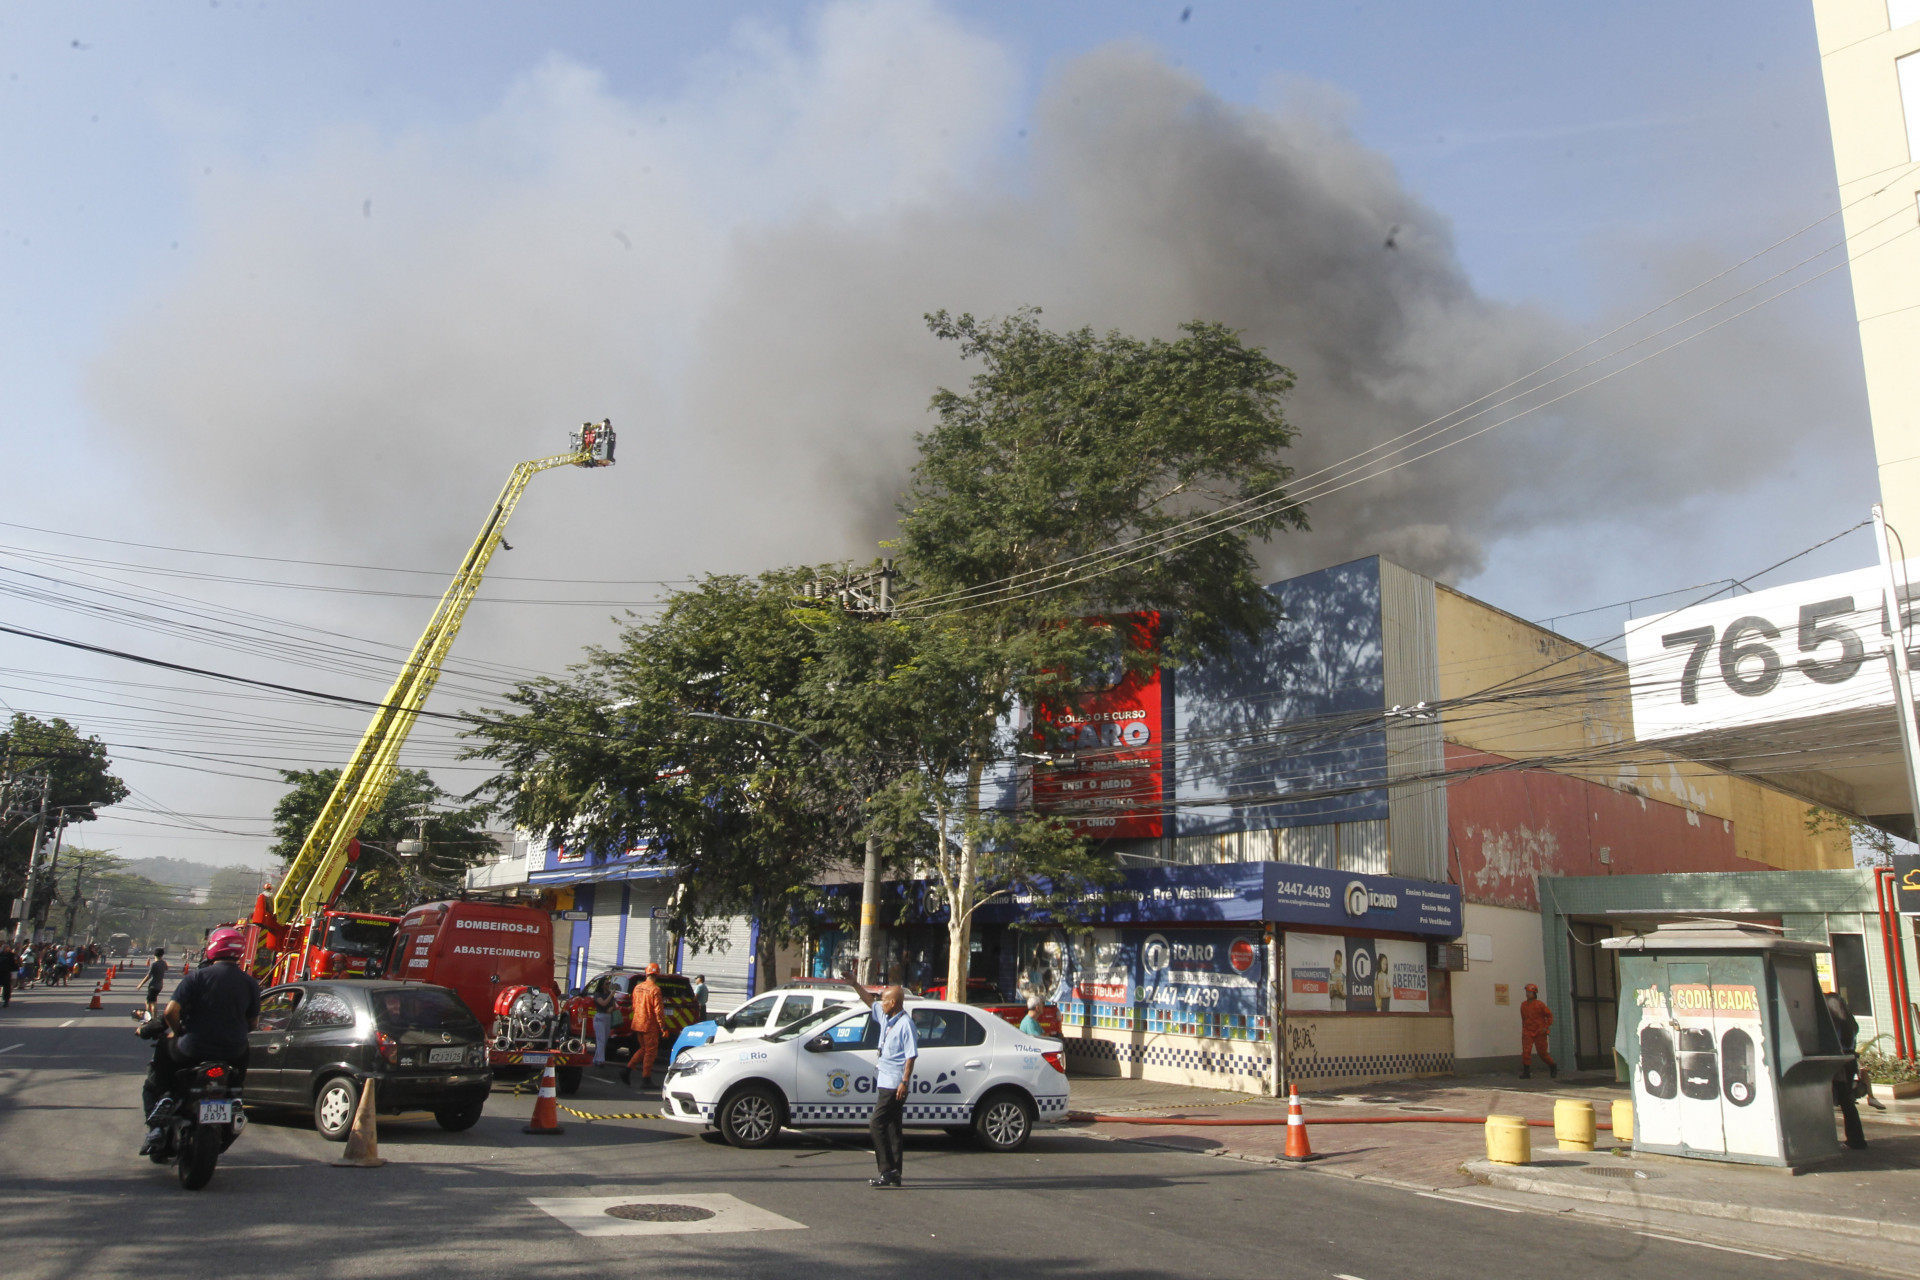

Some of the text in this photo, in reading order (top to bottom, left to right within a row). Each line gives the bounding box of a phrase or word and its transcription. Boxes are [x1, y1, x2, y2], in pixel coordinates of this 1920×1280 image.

[1112, 710, 1146, 720] CURSO
[1045, 721, 1150, 750] CARO
[1062, 780, 1097, 790] ENSIO
[320, 849, 341, 887] BOMBEIROS
[1154, 887, 1172, 900] Pré
[1175, 887, 1236, 900] Vestibular
[1277, 881, 1331, 899] 2447-4439
[1406, 888, 1450, 900] Ensino Fundamental
[456, 920, 540, 934] BOMBEIROS-RJ
[1428, 918, 1452, 926] Vestibular
[454, 946, 541, 959] ABASTECIMENTO
[1294, 970, 1327, 980] FUNDAMENTAL
[1392, 974, 1426, 989] ABERTAS
[1080, 984, 1124, 998] VESTIBULAR
[1352, 983, 1372, 996] ÍCARO
[1144, 986, 1220, 1008] 2447-4439
[1678, 990, 1760, 1010] CODIFICADAS
[836, 1028, 850, 1038] 190
[750, 1052, 768, 1060] Rio
[206, 1104, 225, 1112] RJN
